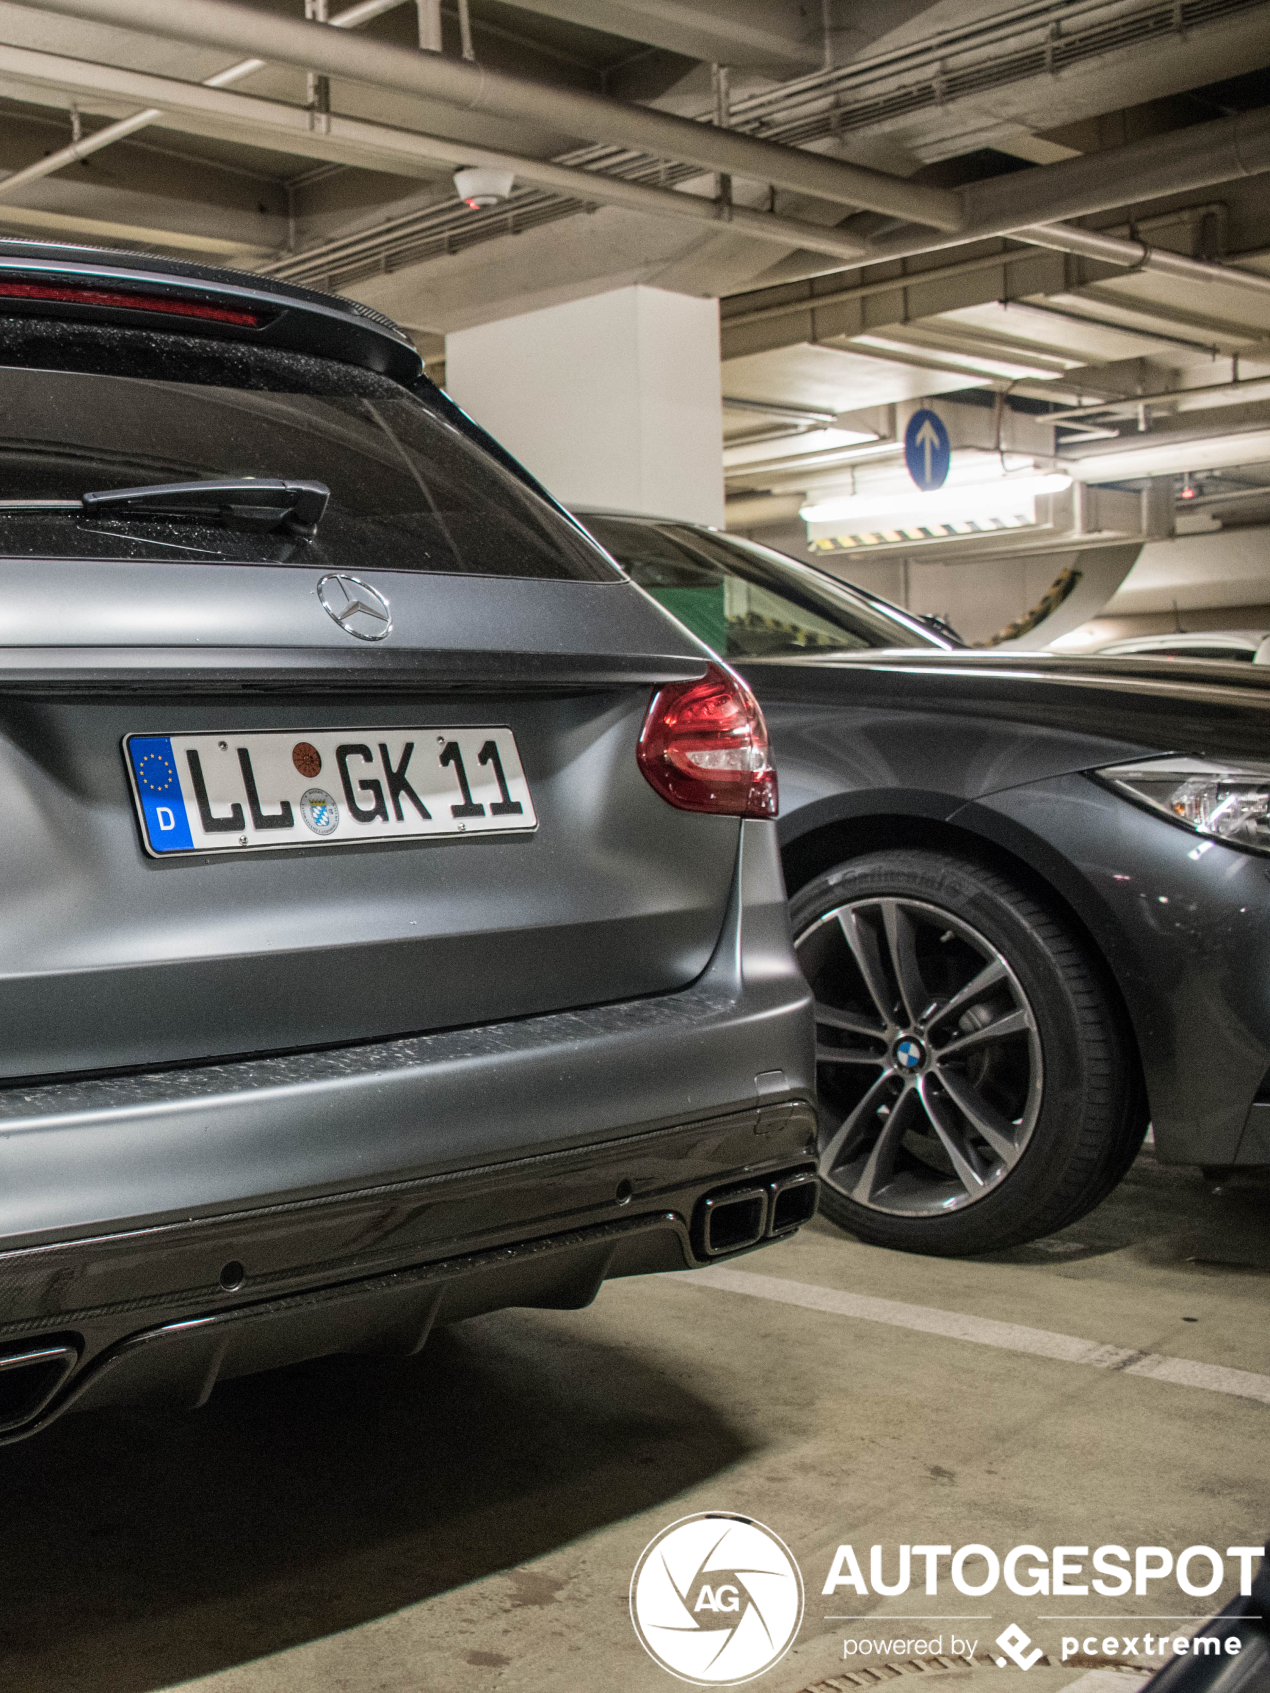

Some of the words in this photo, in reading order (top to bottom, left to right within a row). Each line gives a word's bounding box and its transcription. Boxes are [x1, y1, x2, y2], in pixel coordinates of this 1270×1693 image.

[186, 748, 295, 832] LL
[336, 742, 432, 822] GK
[439, 741, 523, 817] 11
[157, 806, 176, 831] D
